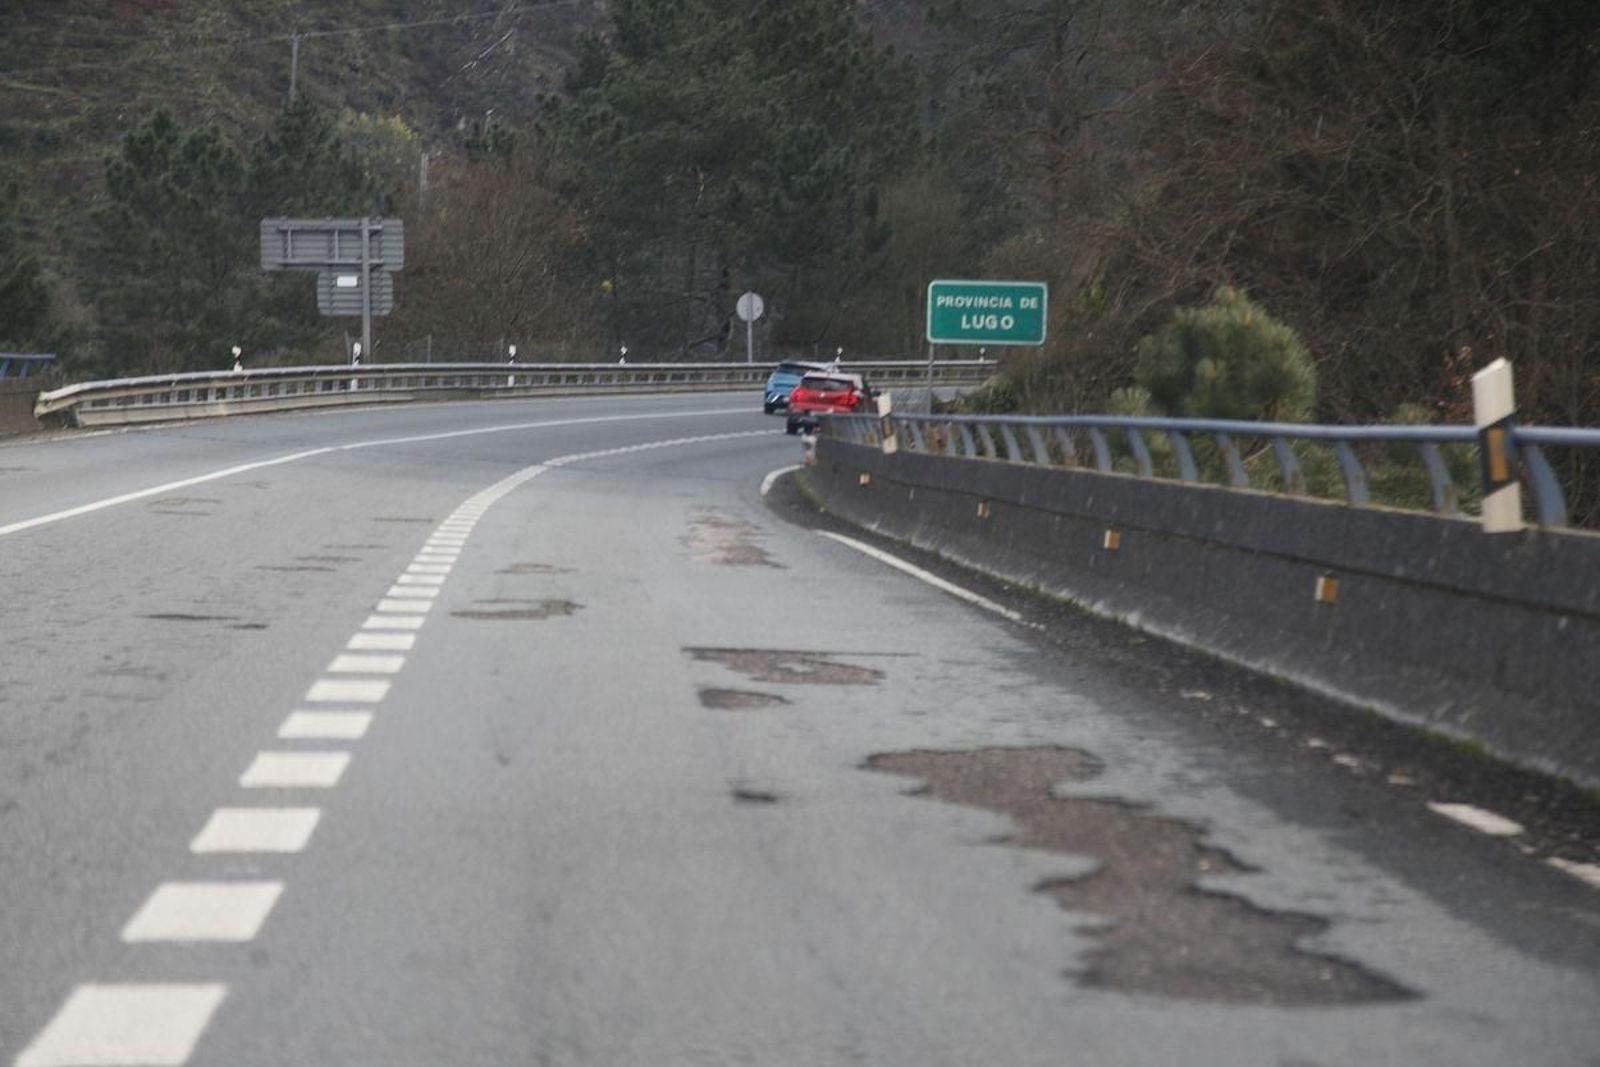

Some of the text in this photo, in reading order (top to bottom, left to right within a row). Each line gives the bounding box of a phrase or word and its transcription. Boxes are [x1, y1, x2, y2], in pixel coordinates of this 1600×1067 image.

[936, 295, 1039, 309] PROVINCIA DE
[961, 314, 1014, 330] LUGO
